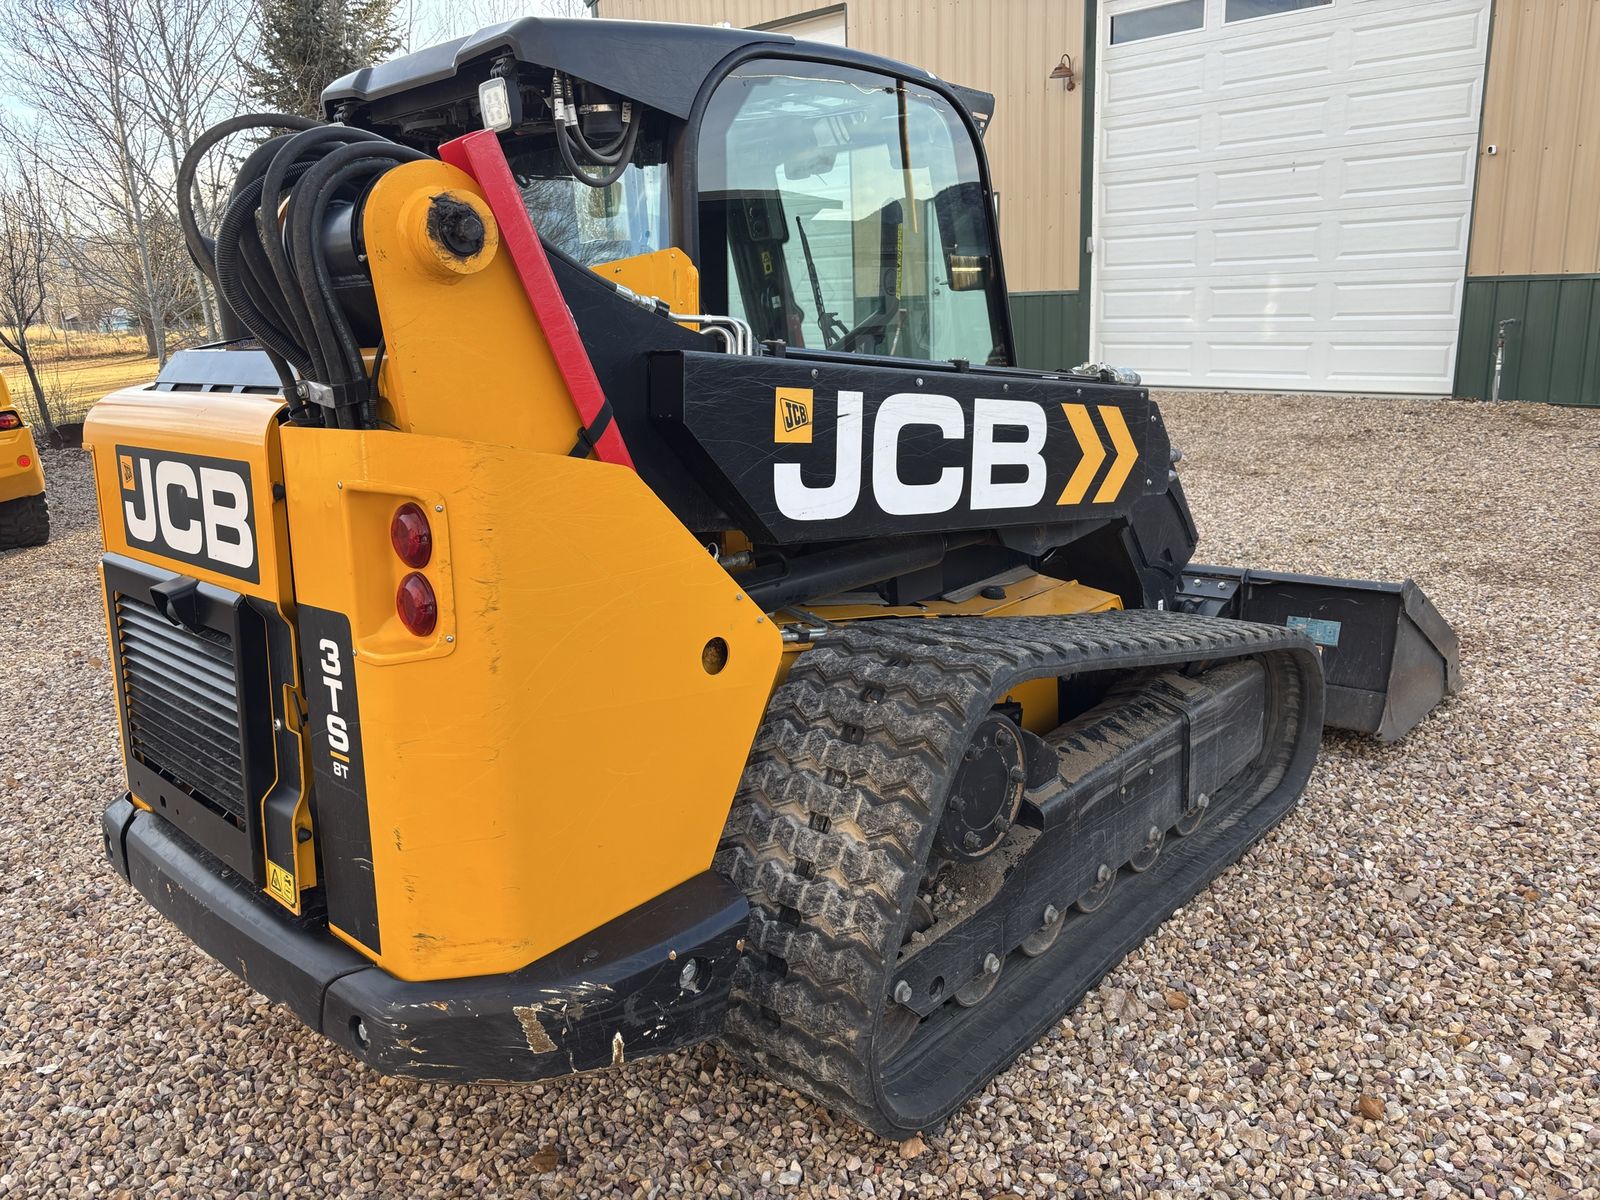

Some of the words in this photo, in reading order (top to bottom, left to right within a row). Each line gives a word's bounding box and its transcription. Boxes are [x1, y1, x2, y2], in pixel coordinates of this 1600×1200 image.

[774, 390, 1047, 521] JCB
[785, 402, 806, 428] JCB
[125, 458, 253, 568] JCB
[320, 638, 349, 753] 3TS
[333, 761, 349, 779] 8T
